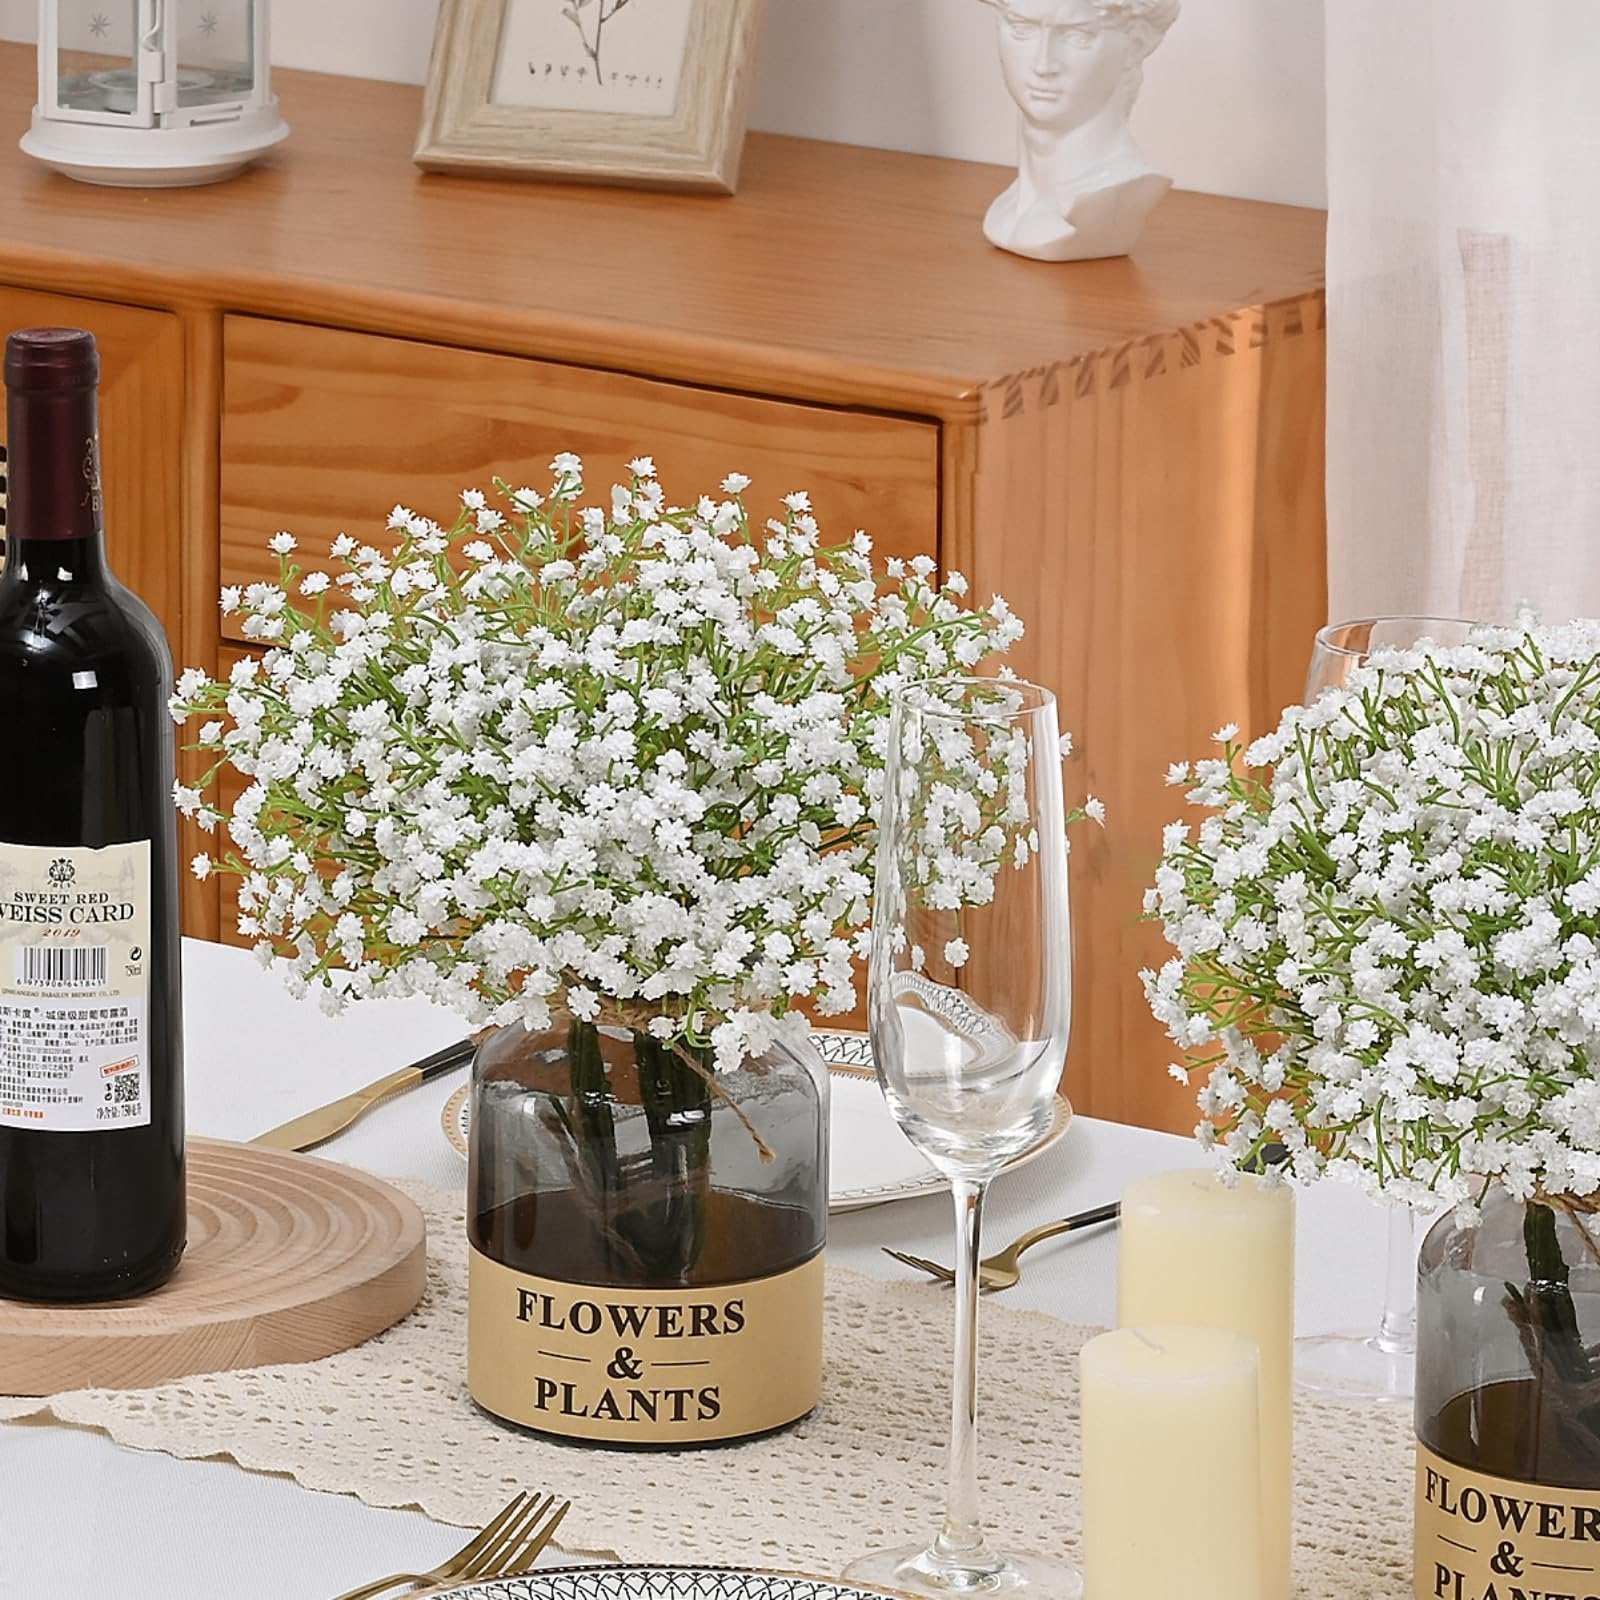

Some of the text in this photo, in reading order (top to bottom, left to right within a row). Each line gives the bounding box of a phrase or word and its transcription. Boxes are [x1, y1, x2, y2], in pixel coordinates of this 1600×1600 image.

[14, 891, 109, 905] SWEET RED
[70, 903, 134, 923] CARD
[42, 928, 80, 937] 2019
[516, 1287, 746, 1339] FLOWERS
[607, 1346, 643, 1380] &
[534, 1376, 721, 1422] PLANTS
[1490, 1540, 1524, 1578] &
